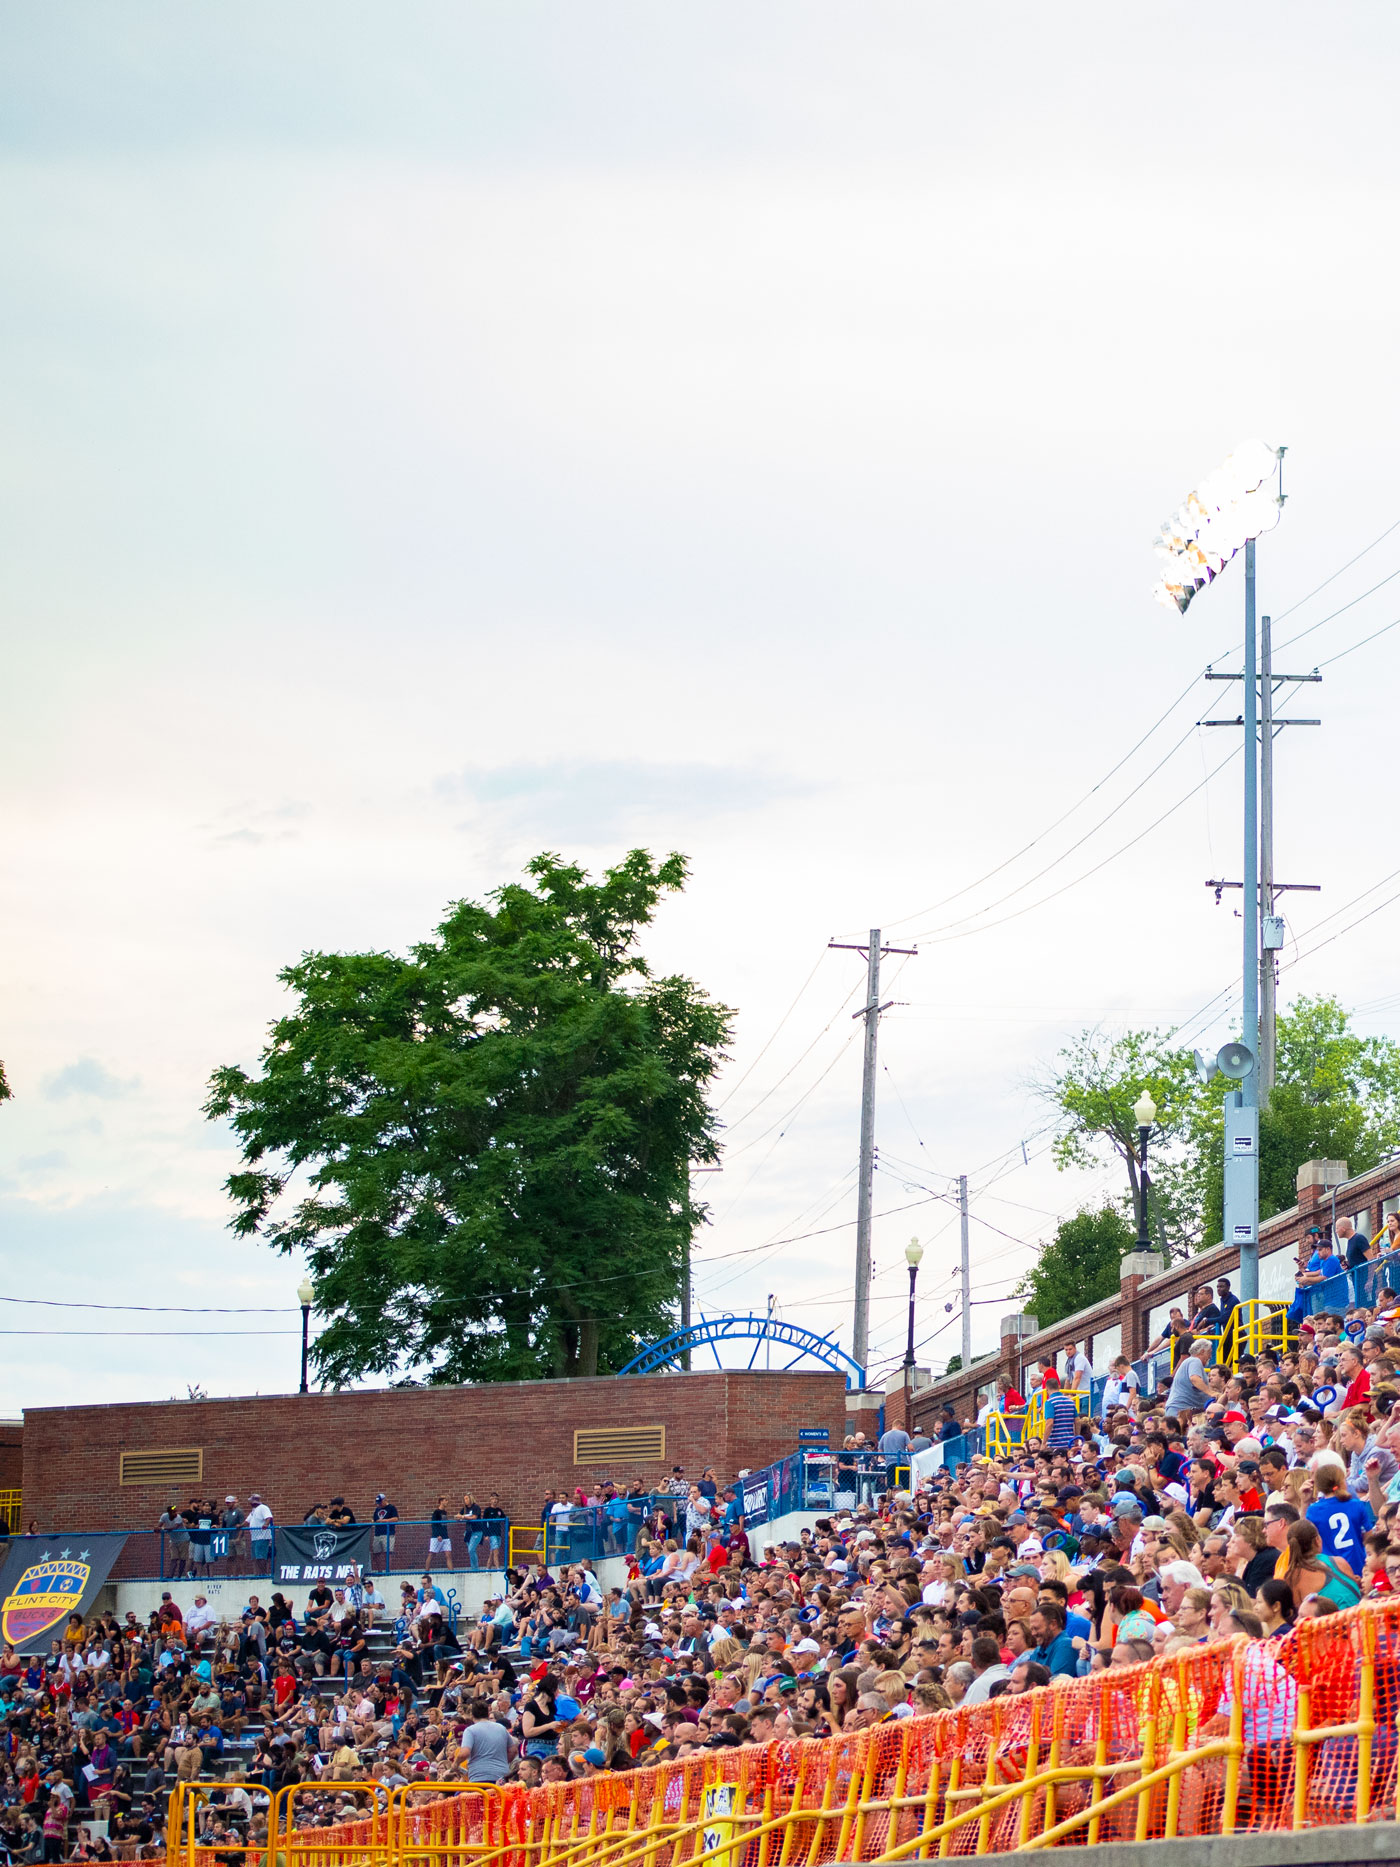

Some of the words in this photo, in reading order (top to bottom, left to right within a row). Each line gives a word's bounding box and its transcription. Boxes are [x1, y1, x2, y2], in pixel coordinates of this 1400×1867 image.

[1328, 1512, 1354, 1550] 2
[212, 1536, 226, 1554] 11
[280, 1565, 300, 1579] THE
[303, 1565, 333, 1579] RATS
[8, 1596, 47, 1607] FLINT
[48, 1596, 78, 1605] CITY
[14, 1609, 57, 1620] BUCKS
